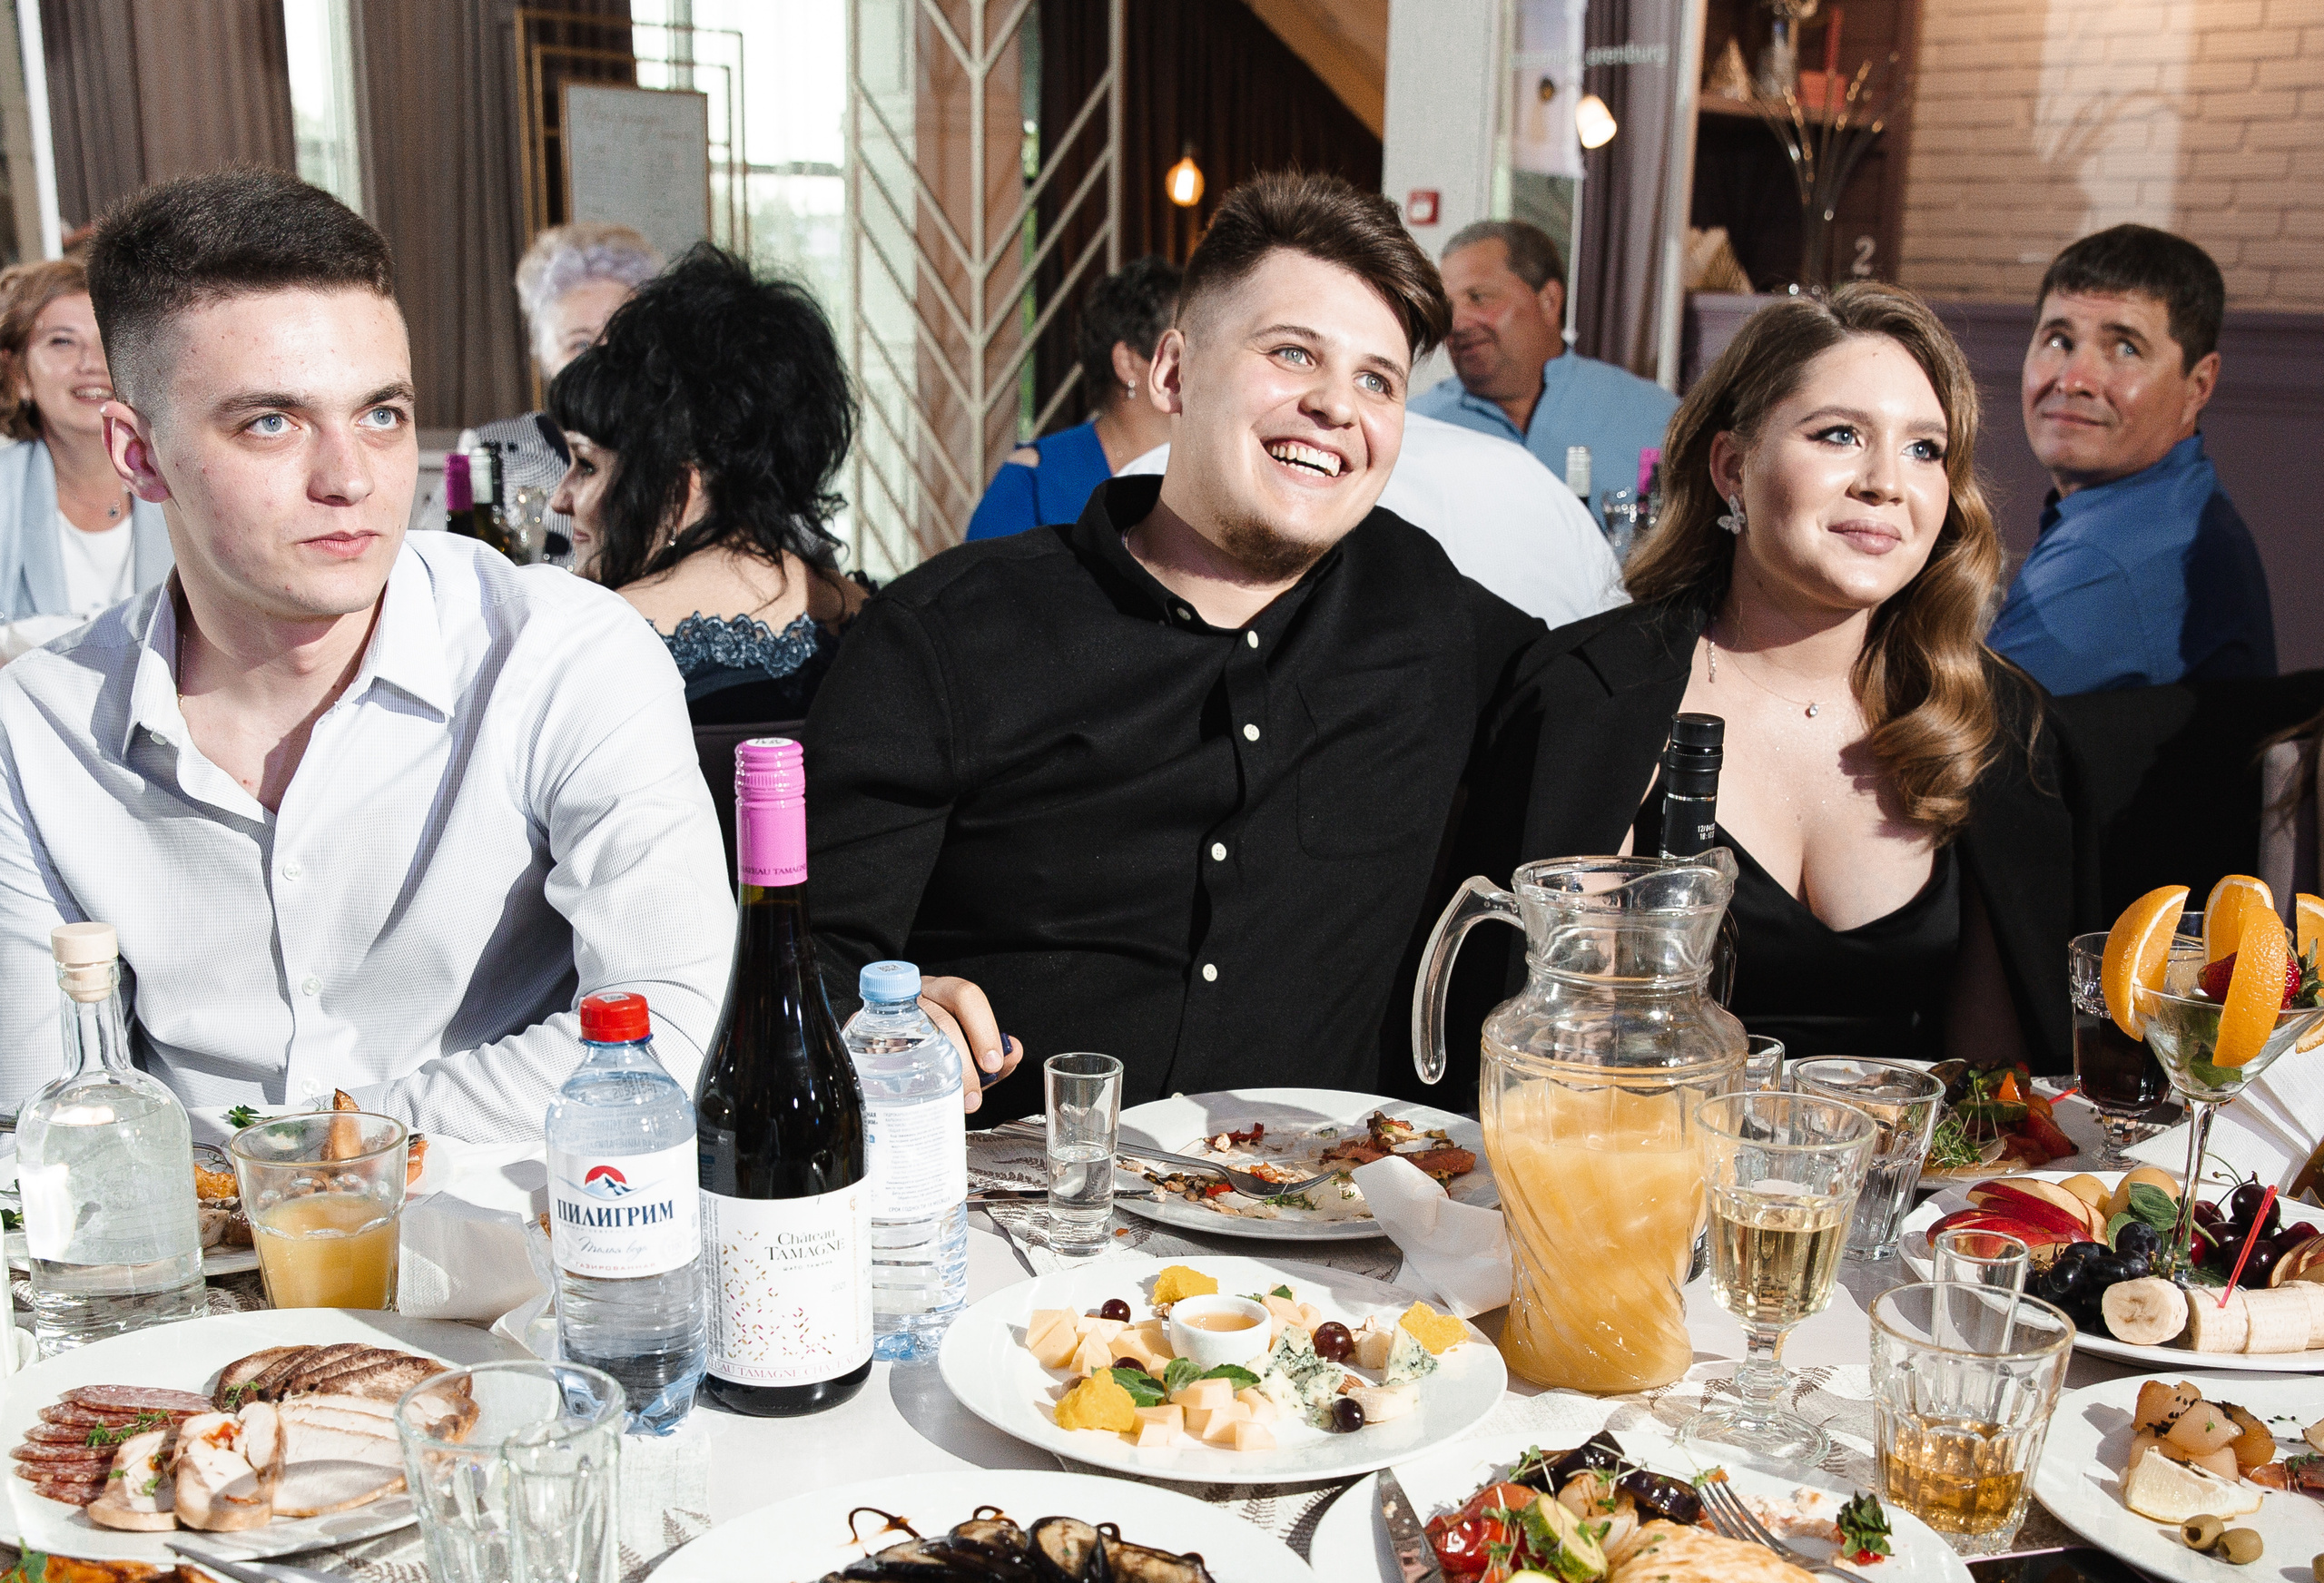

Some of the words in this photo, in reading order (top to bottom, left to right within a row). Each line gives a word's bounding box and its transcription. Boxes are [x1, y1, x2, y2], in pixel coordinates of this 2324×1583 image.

[1850, 234, 1876, 276] 2
[556, 1198, 674, 1227] ПИЛИГРИМ
[777, 1229, 835, 1246] Château
[764, 1238, 845, 1261] TAMAGNE
[575, 1262, 655, 1272] ГАЗИРОВАННАЯ
[737, 1366, 800, 1379] TAMAGNE
